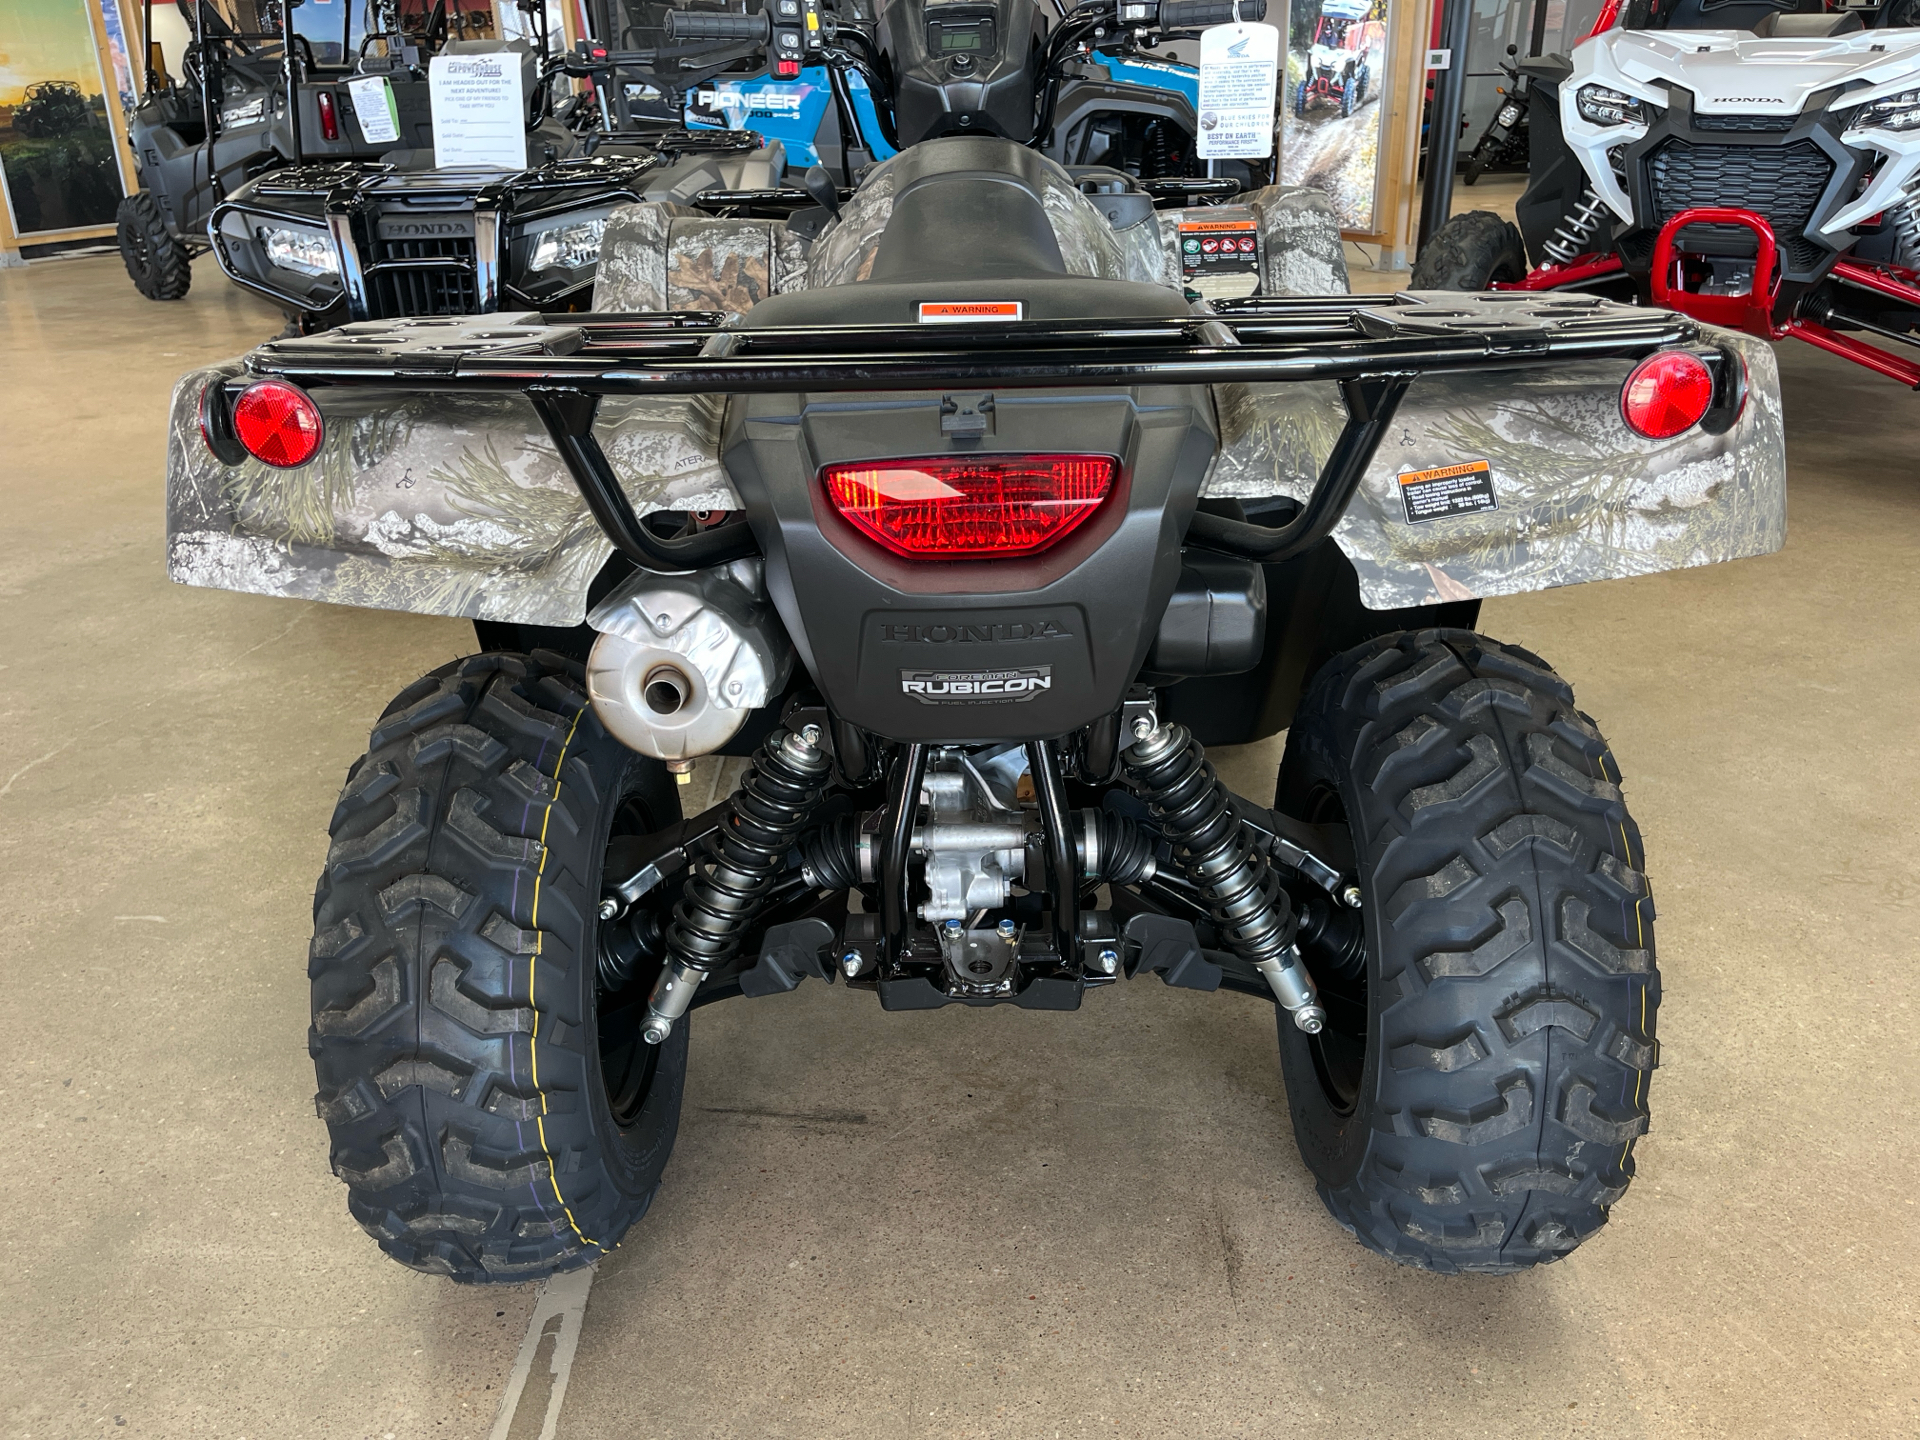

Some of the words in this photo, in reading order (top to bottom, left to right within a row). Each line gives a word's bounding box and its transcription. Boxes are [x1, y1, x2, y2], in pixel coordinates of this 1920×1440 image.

[458, 65, 502, 73] POWERHOUSE
[698, 91, 801, 110] PIONEER
[224, 103, 262, 122] PIONEER
[387, 224, 470, 235] HONDA
[1423, 464, 1474, 479] WARNING
[881, 620, 1073, 644] HONDA
[935, 672, 1018, 681] FOREMAN
[902, 676, 1051, 694] RUBICON
